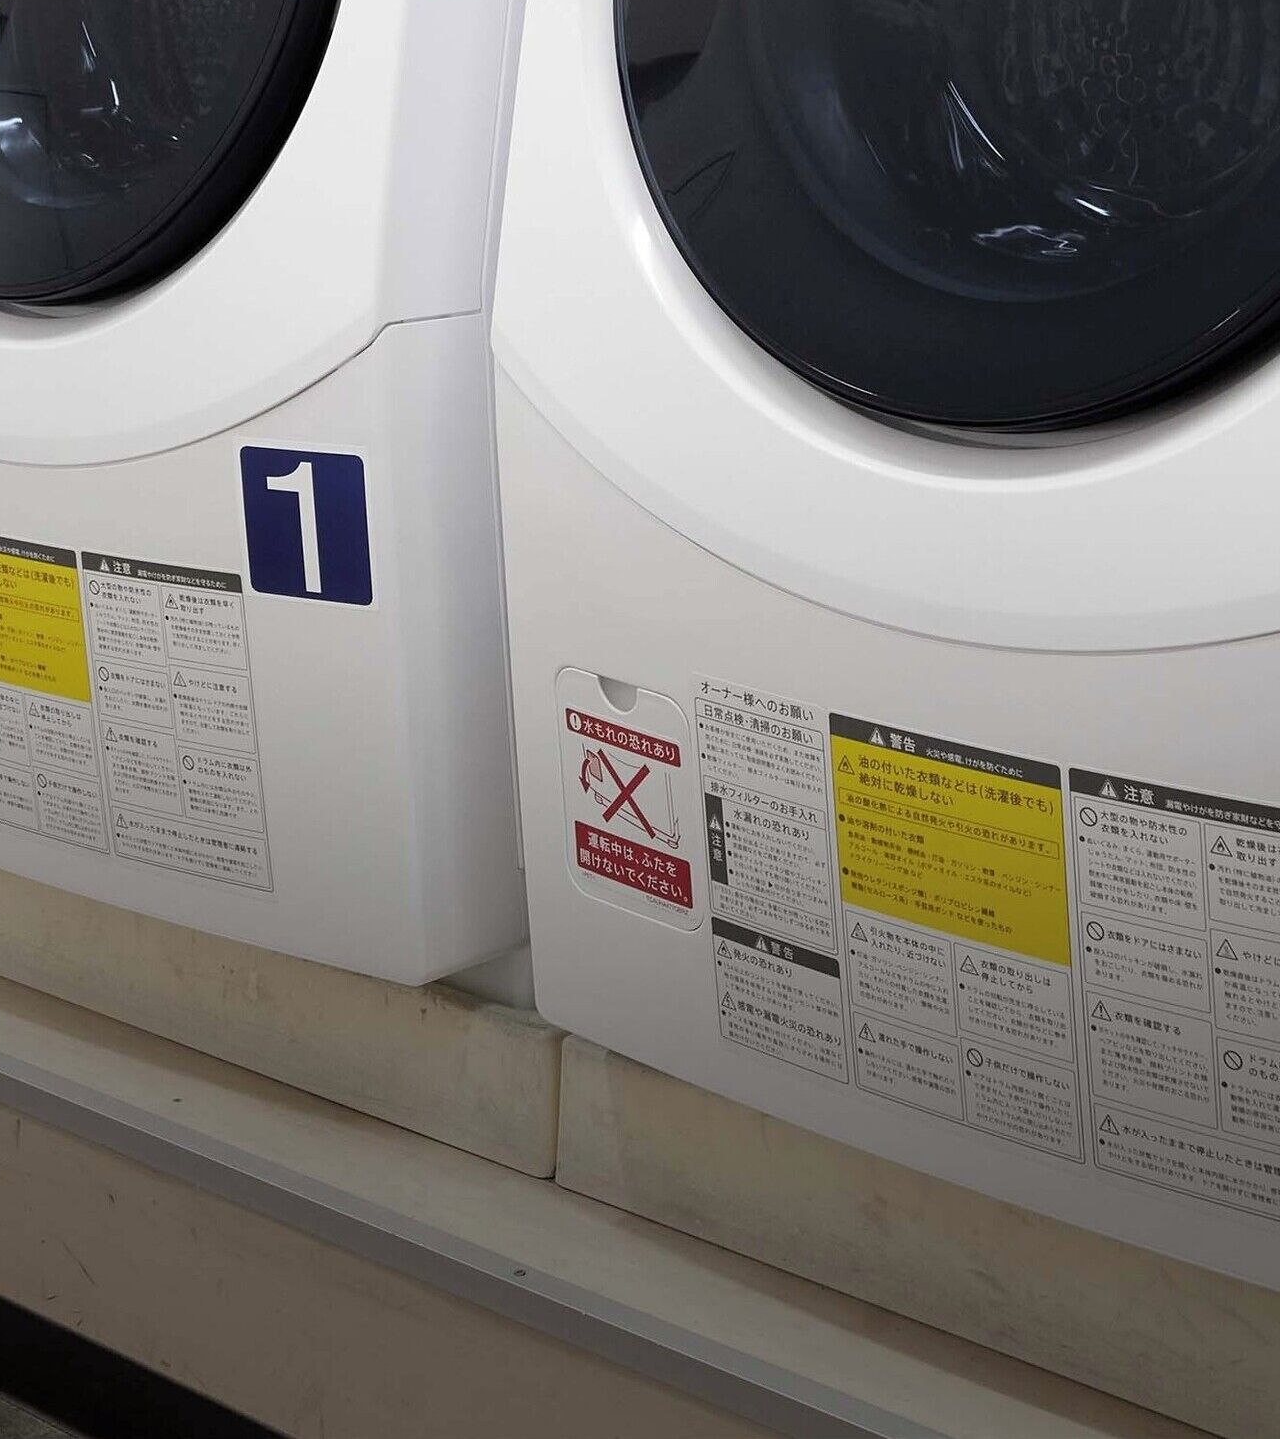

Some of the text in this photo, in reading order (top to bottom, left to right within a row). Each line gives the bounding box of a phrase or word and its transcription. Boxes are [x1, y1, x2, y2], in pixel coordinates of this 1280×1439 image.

[265, 461, 322, 594] 1
[113, 561, 132, 575] 注意
[701, 681, 814, 721] オーナー様へのお願い
[704, 704, 814, 744] 日常点検・清掃のお願い
[583, 718, 676, 762] 水もれの恐れあり
[889, 732, 916, 754] 警告
[710, 781, 818, 824] 排水フィルターのお手入れ
[859, 771, 954, 806] 絶対に乾燥しない
[1123, 784, 1155, 806] 注意
[733, 809, 810, 841] 水漏れの恐れあり
[847, 816, 925, 844] 油や溶剤の付いた衣類
[1100, 810, 1188, 837] 大型の物や防水性の
[1101, 823, 1170, 845] 衣類を入れない
[587, 830, 677, 879] 運転中は、ふたを
[1236, 849, 1278, 868] 取り出す
[580, 847, 689, 902] 開けないでください。
[870, 925, 945, 957] 引火物を本体の中に
[871, 939, 947, 968] 入れたり、近づけない
[1107, 931, 1202, 961] 衣類をドアにはさまない
[733, 948, 793, 978] 発火の恐れあり
[980, 959, 1052, 987] 衣類の取り出しは
[981, 972, 1034, 995] 停止してから
[738, 1000, 842, 1046] 感電や漏電火災の恐れあり
[1114, 1012, 1182, 1036] 衣類を確認する
[985, 1057, 1070, 1091] 子供だけで操作しない
